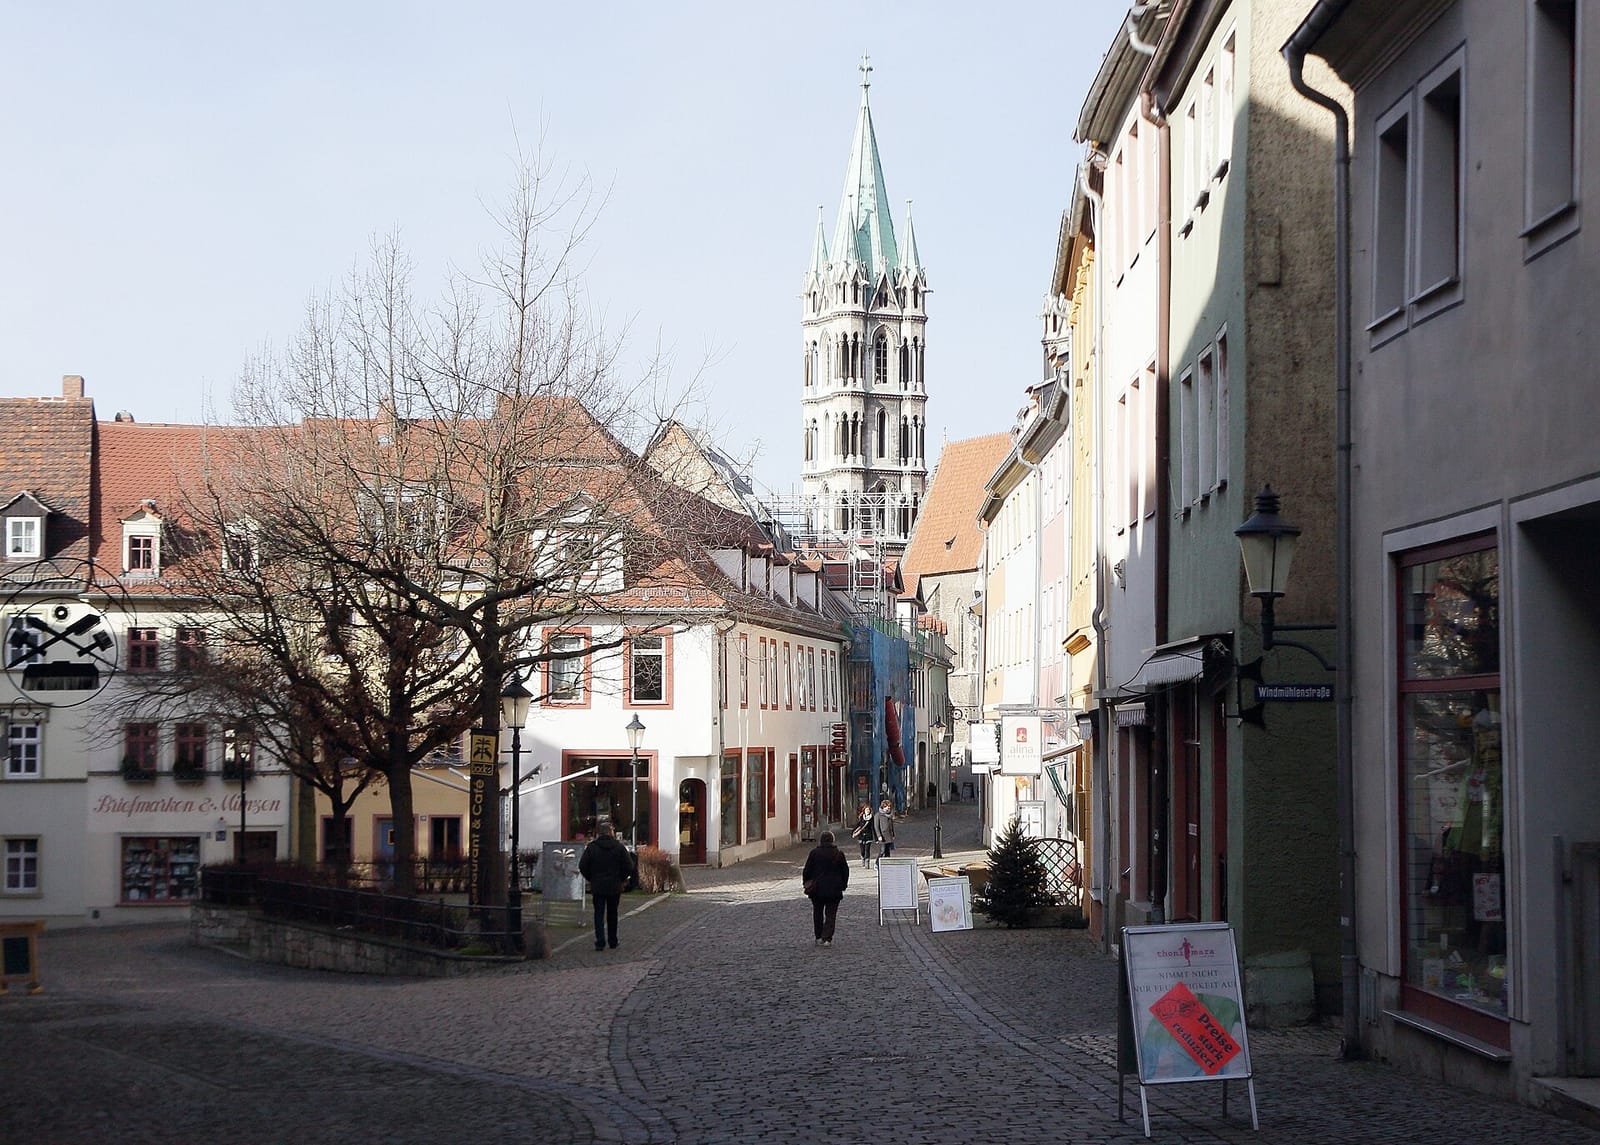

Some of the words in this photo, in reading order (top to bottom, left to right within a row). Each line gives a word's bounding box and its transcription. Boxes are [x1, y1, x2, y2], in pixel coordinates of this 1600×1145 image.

[1258, 687, 1331, 698] Windmühlenstraße
[93, 795, 194, 817] Briefmarken
[199, 798, 216, 815] &
[221, 794, 281, 814] Münzen
[472, 779, 485, 816] Café
[472, 819, 482, 829] &
[1159, 971, 1188, 979] NIMMT
[1190, 969, 1218, 977] NICHT
[1134, 985, 1152, 993] NUR
[1154, 983, 1218, 992] FEUIGKEIT
[1198, 1013, 1233, 1053] Preise
[1172, 1022, 1215, 1069] reduziert
[1198, 1034, 1224, 1061] stark
